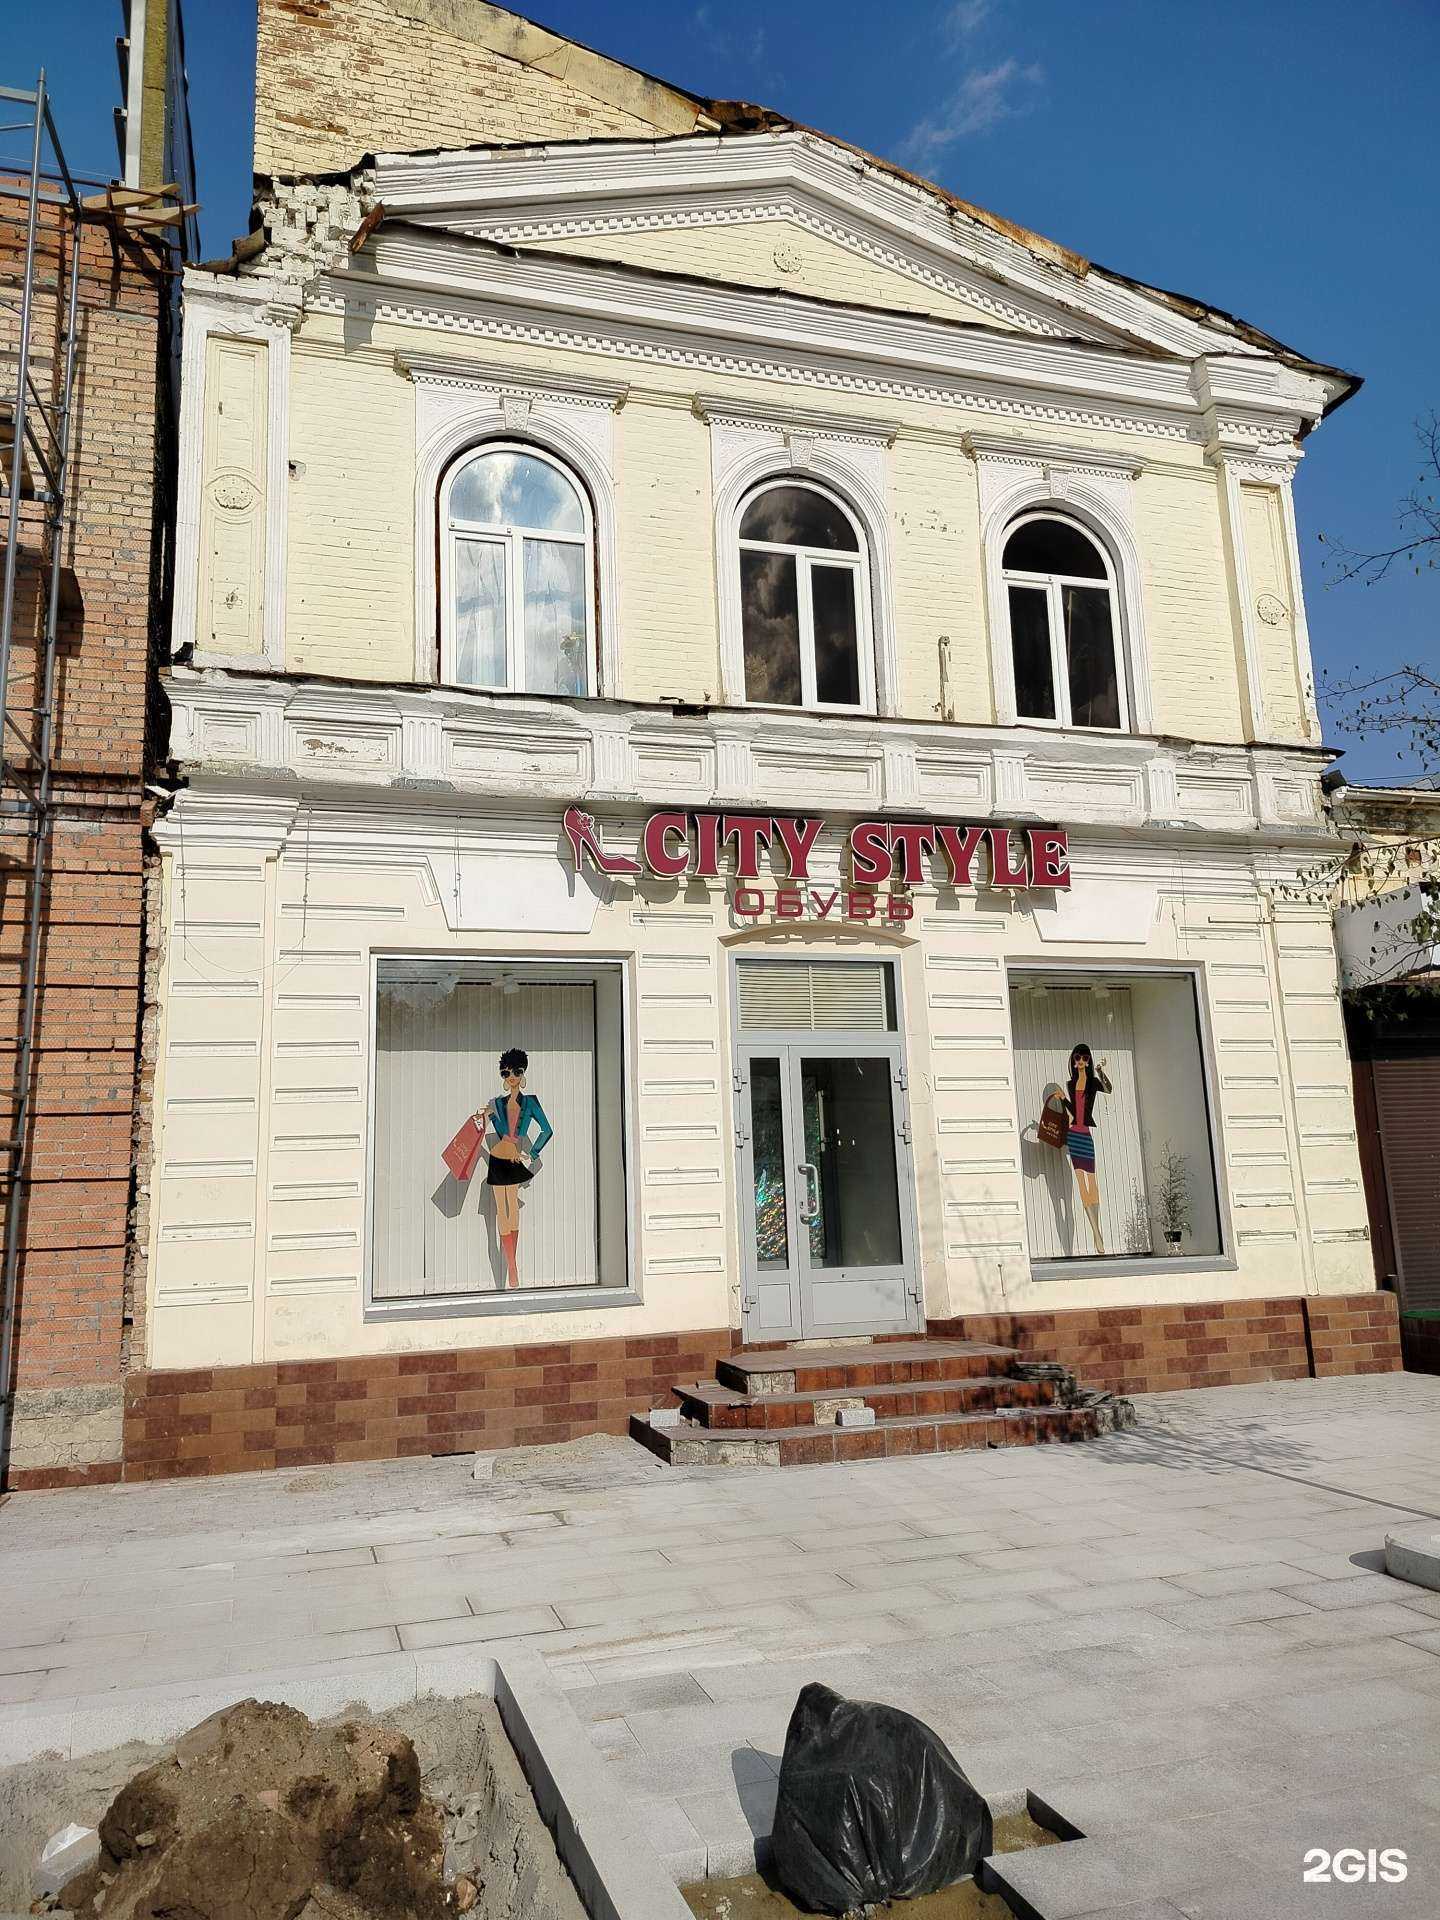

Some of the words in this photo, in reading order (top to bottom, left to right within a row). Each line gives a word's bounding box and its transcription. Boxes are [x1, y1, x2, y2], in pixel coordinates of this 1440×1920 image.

[644, 812, 825, 881] CITY
[851, 822, 1072, 891] STYLE
[735, 888, 914, 920] ОБУВЬ
